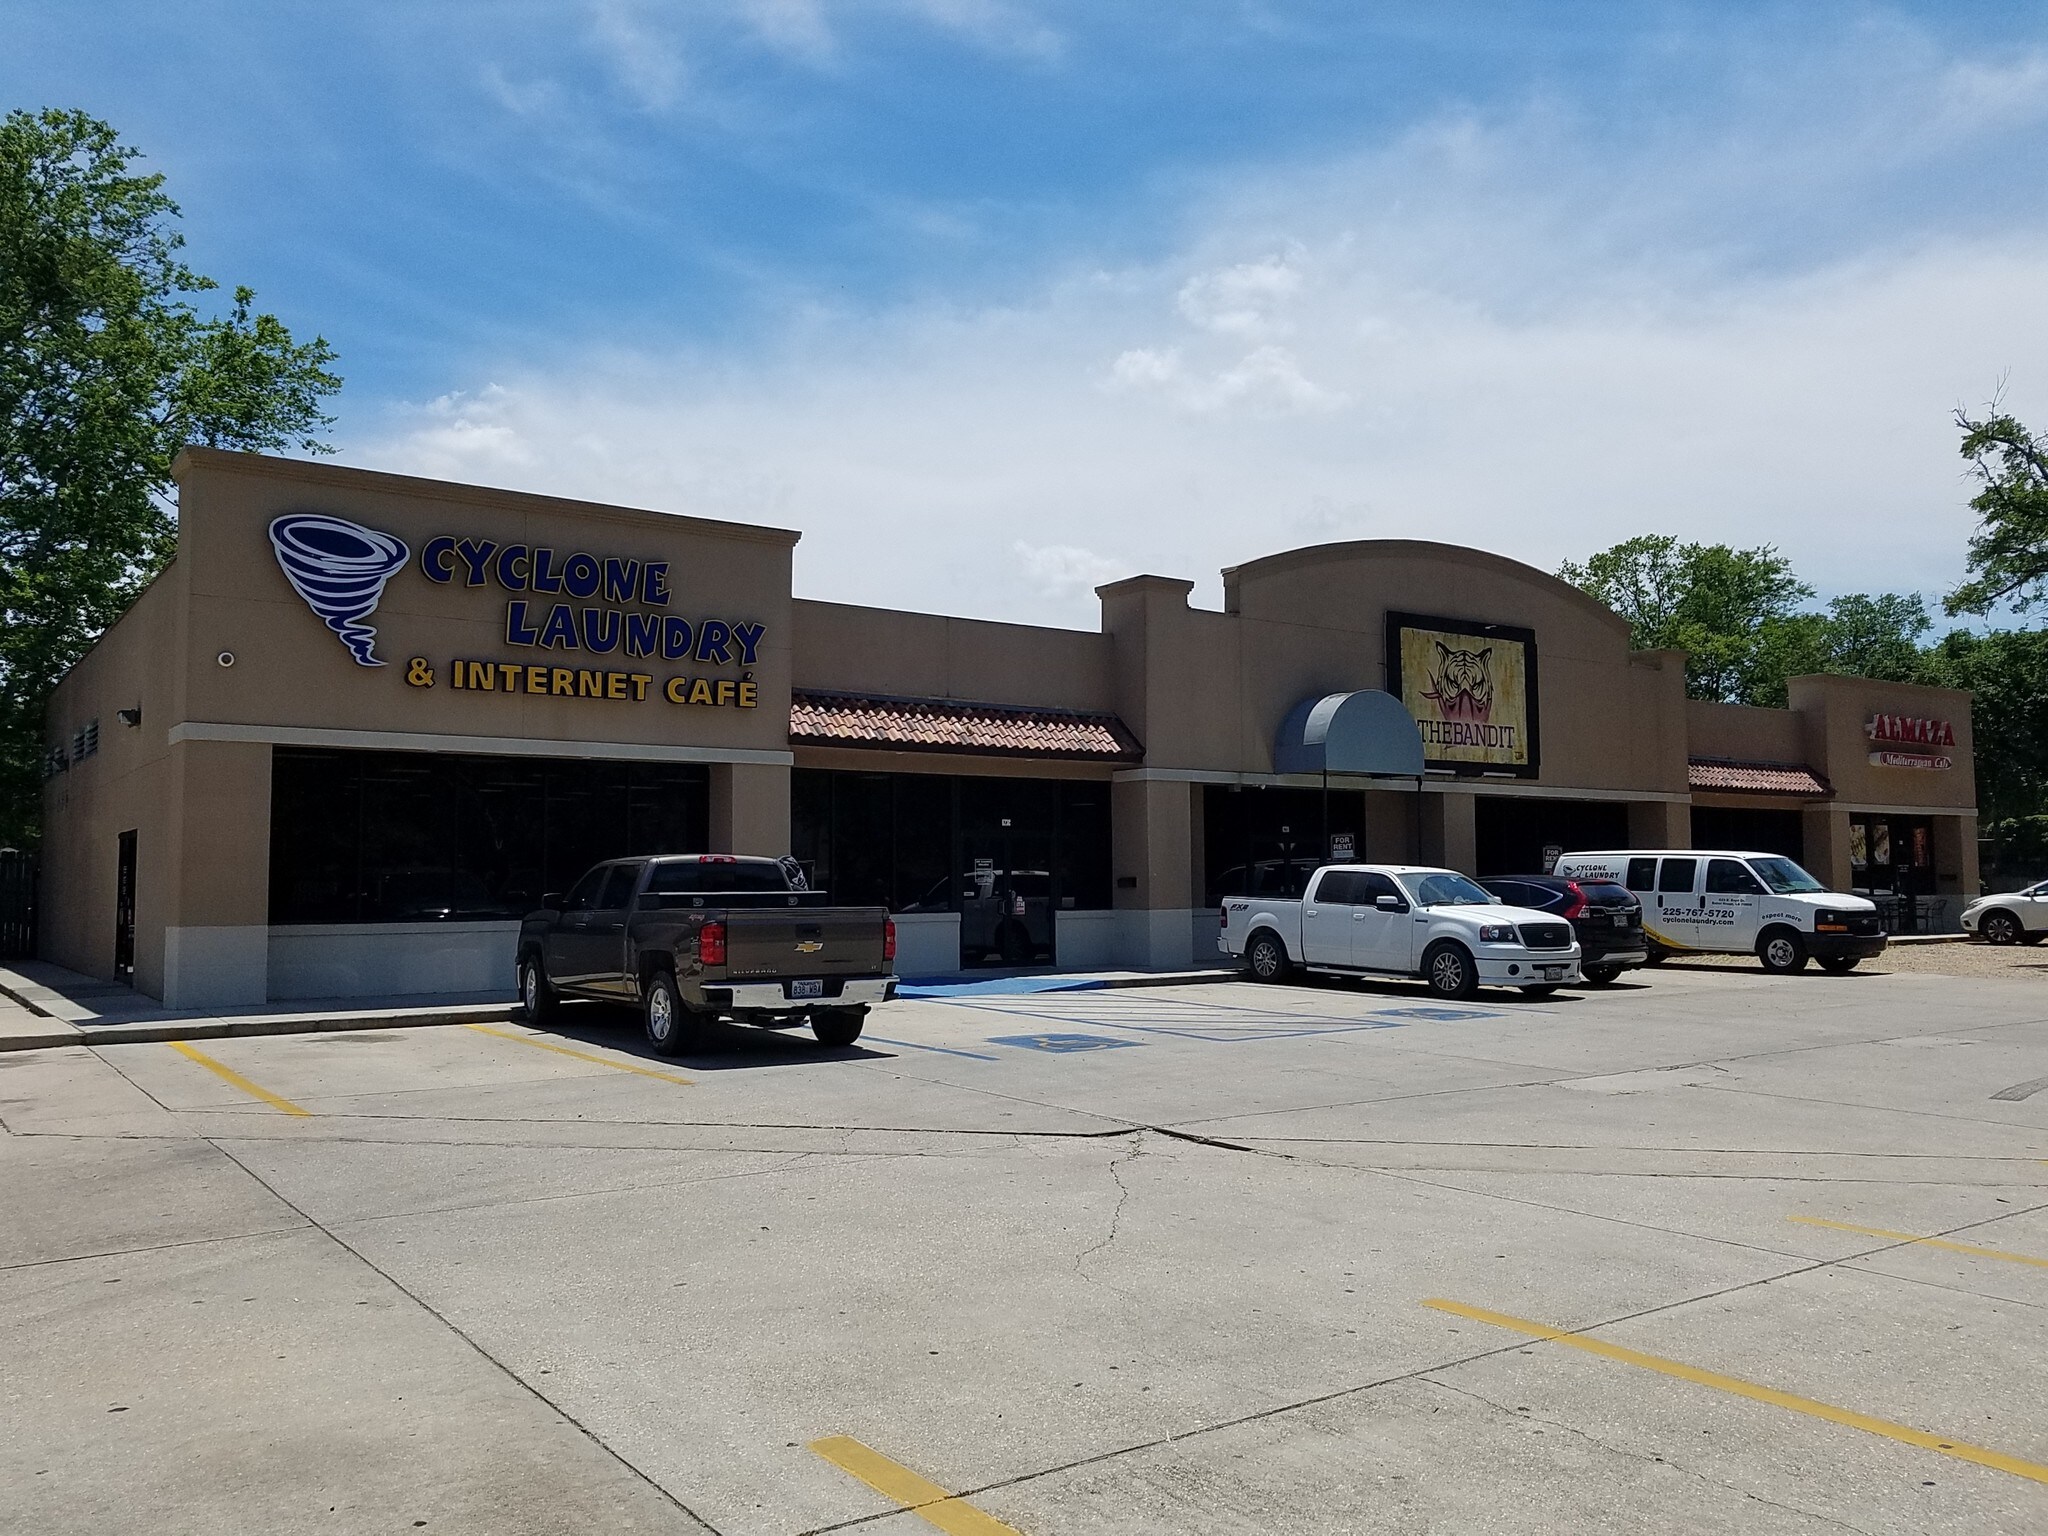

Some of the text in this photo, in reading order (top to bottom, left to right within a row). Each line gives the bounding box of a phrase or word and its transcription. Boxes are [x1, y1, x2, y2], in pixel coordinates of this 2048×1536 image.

[422, 536, 672, 606] CYCLONE
[506, 600, 768, 666] LAUNDRY
[406, 656, 758, 708] & INTERNET CAFÉ
[1417, 719, 1515, 749] THEBANDIT
[1869, 713, 1956, 747] ALMAZA
[1576, 864, 1608, 872] CYCLONE
[1662, 908, 1735, 918] 225-767-5720
[1662, 916, 1735, 926] cyclonelaundry.com
[1761, 912, 1802, 922] expect more
